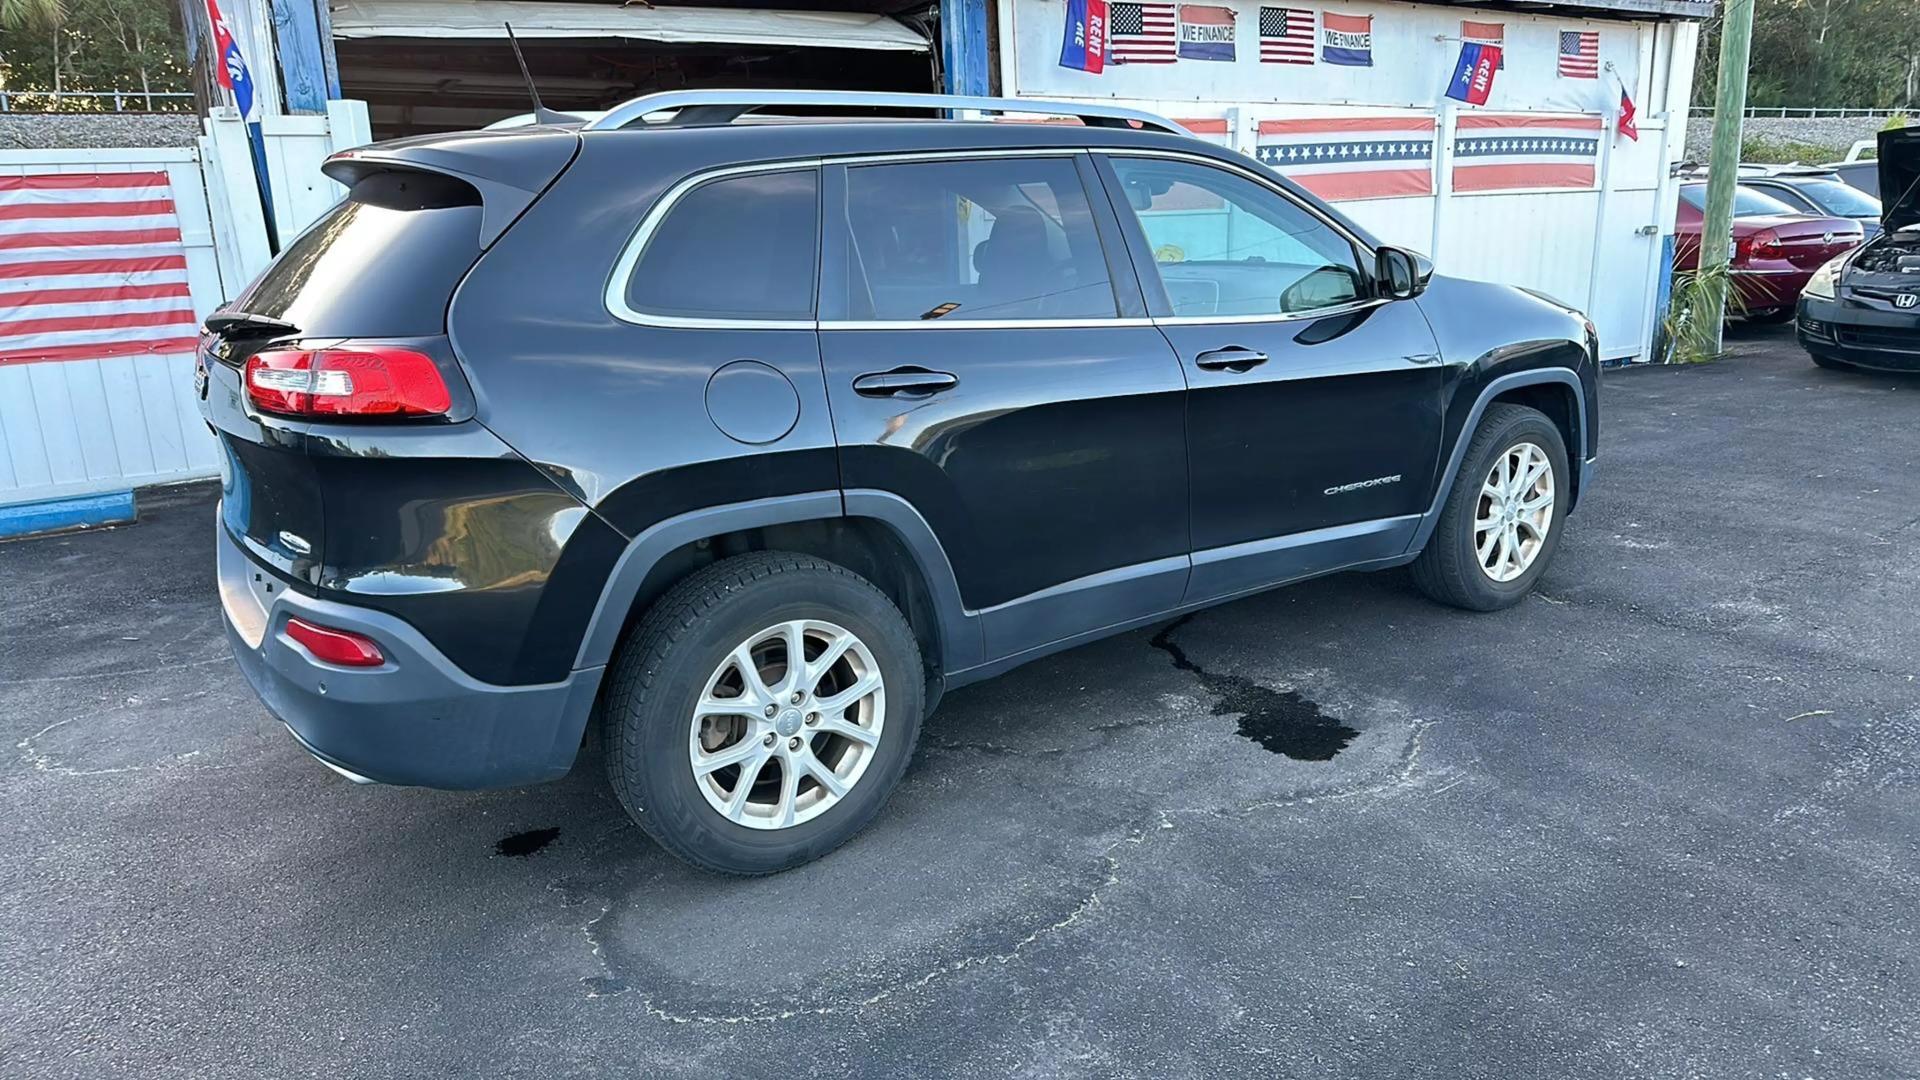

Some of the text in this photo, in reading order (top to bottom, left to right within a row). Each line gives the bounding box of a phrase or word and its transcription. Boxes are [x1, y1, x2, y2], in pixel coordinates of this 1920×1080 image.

[1074, 21, 1085, 48] ME
[1088, 14, 1102, 57] RENT
[1182, 24, 1234, 41] WE FINANCE
[1325, 30, 1370, 48] WE FINANCE
[1474, 59, 1491, 92] RENT
[1324, 475, 1402, 495] CHEROKEE
